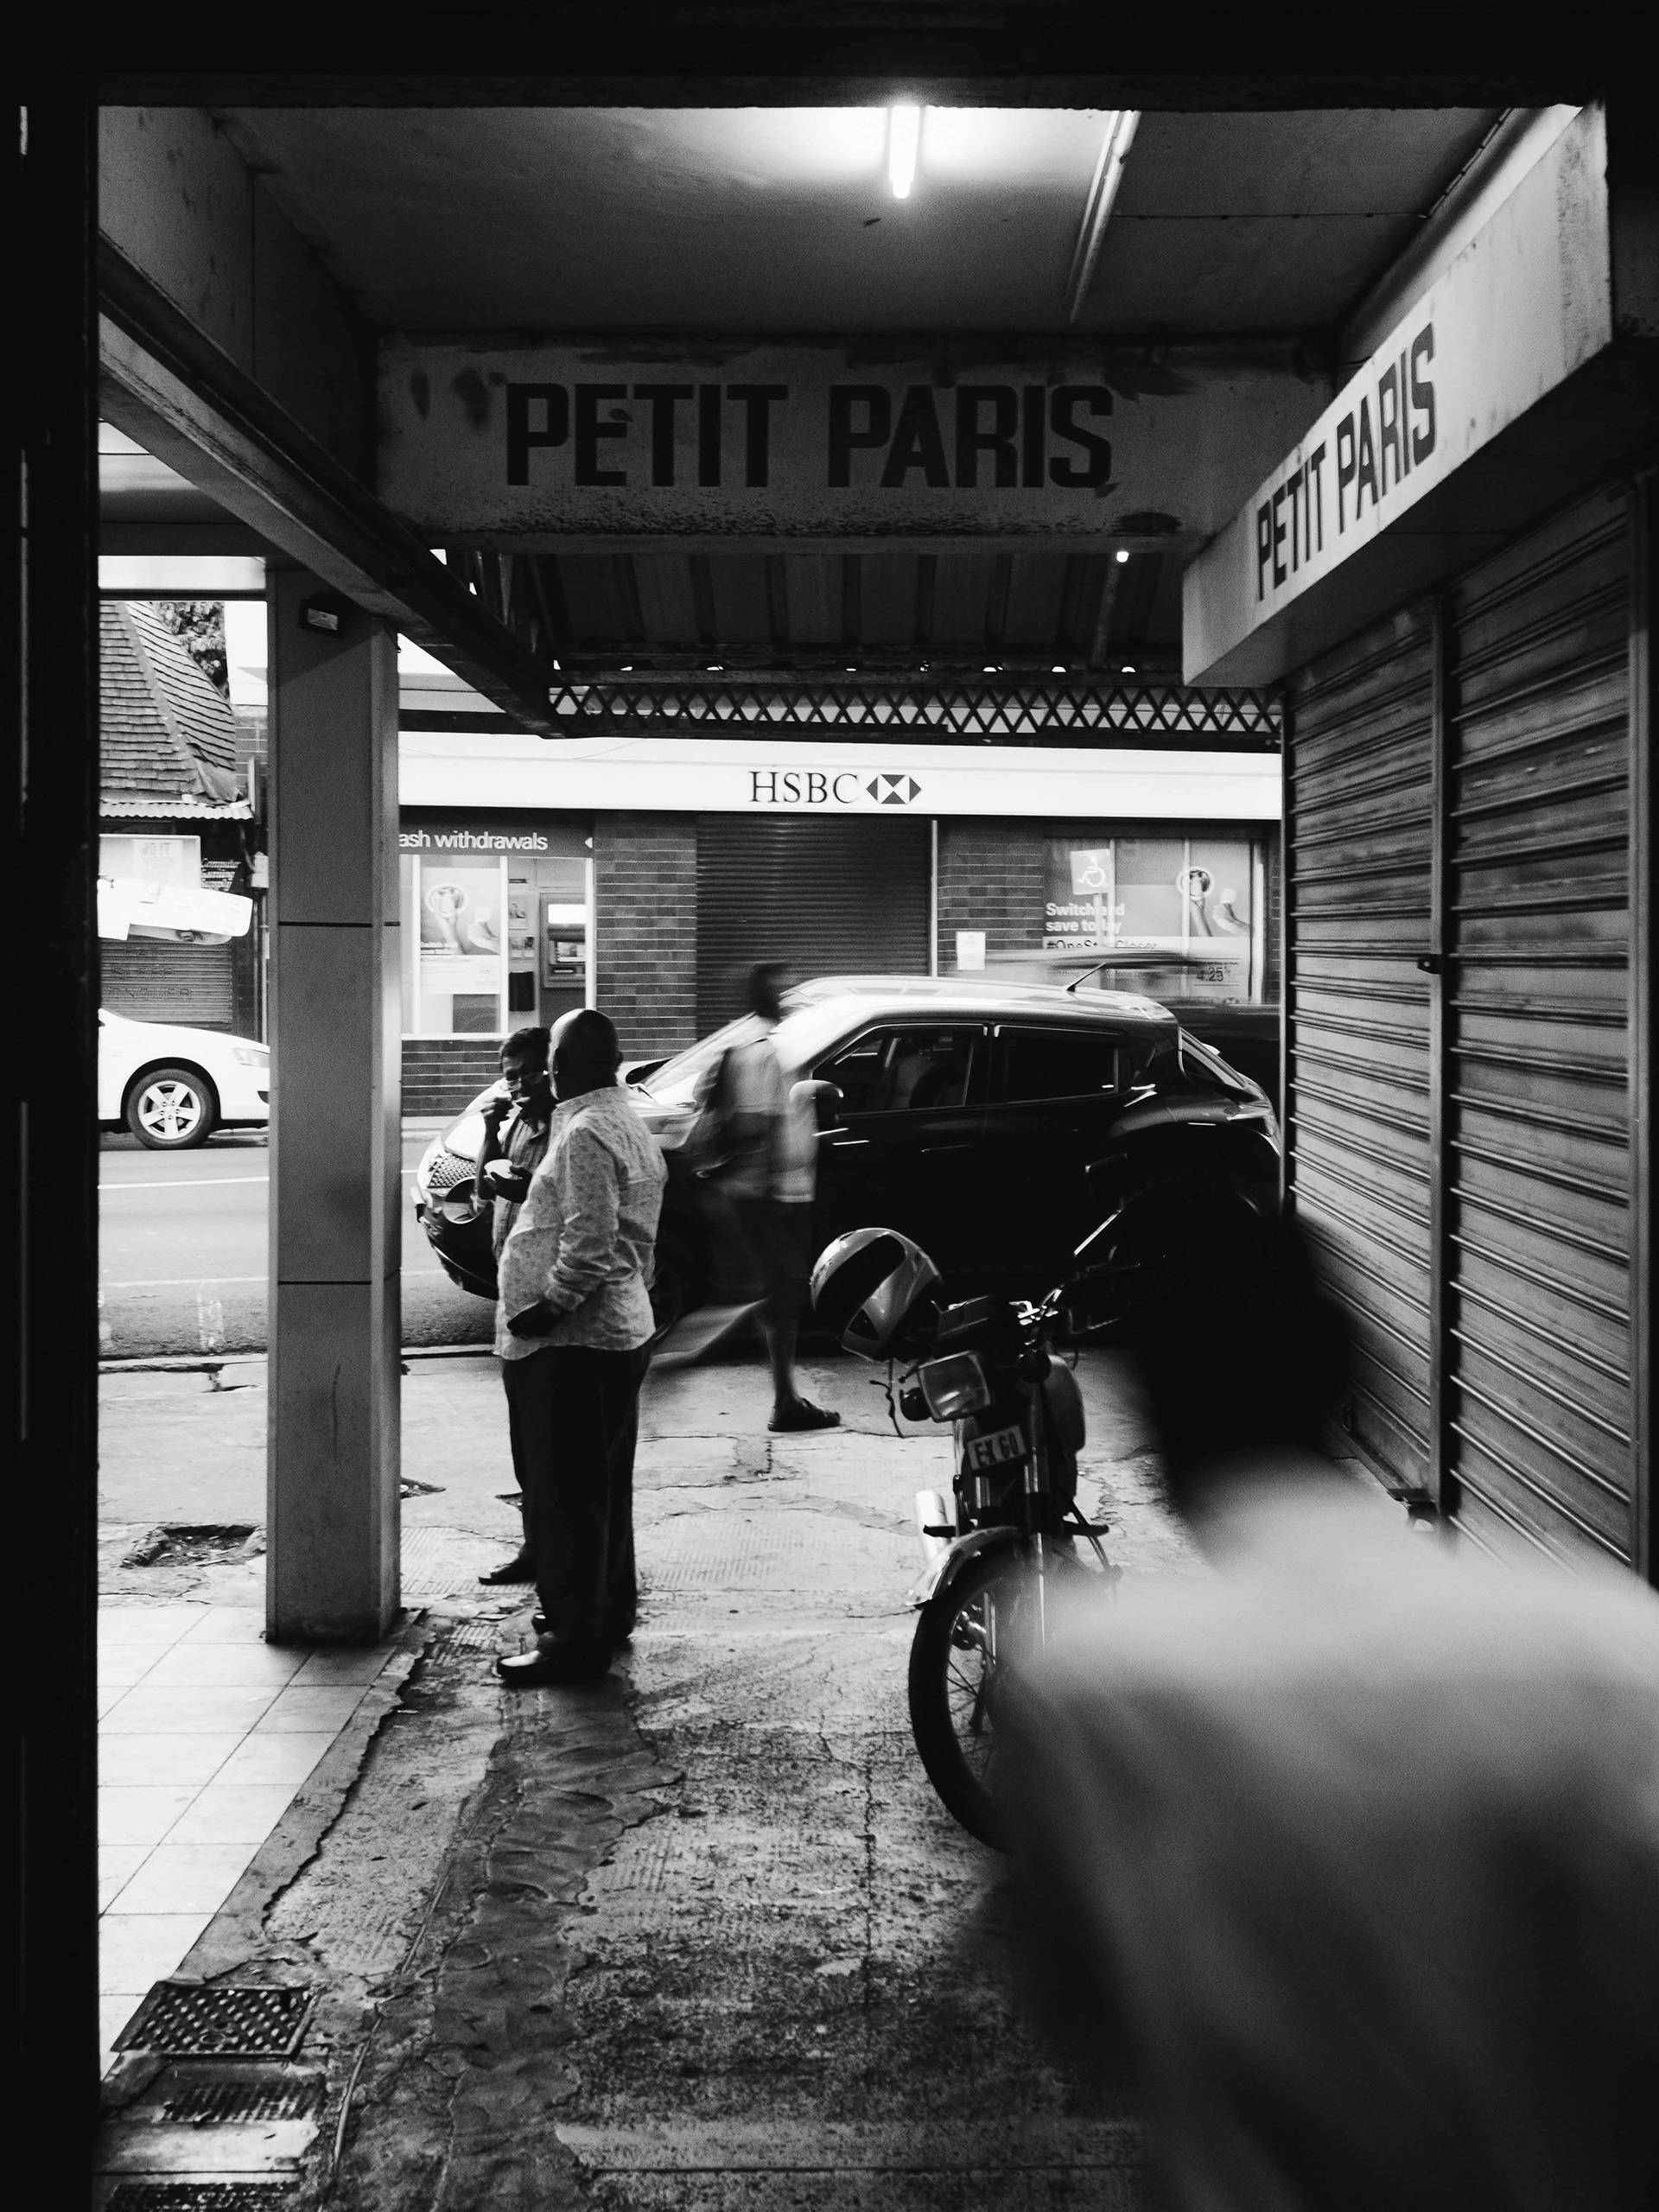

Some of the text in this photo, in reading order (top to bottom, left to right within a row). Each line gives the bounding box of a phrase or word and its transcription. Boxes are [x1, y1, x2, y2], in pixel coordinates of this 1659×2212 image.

[507, 383, 1115, 488] PETIT PARIS
[1257, 321, 1437, 601] PETIT PARIS
[748, 771, 859, 804] HSBC
[434, 830, 548, 850] withdrawals
[1046, 902, 1126, 917] Switch ad
[1046, 918, 1122, 935] save toy
